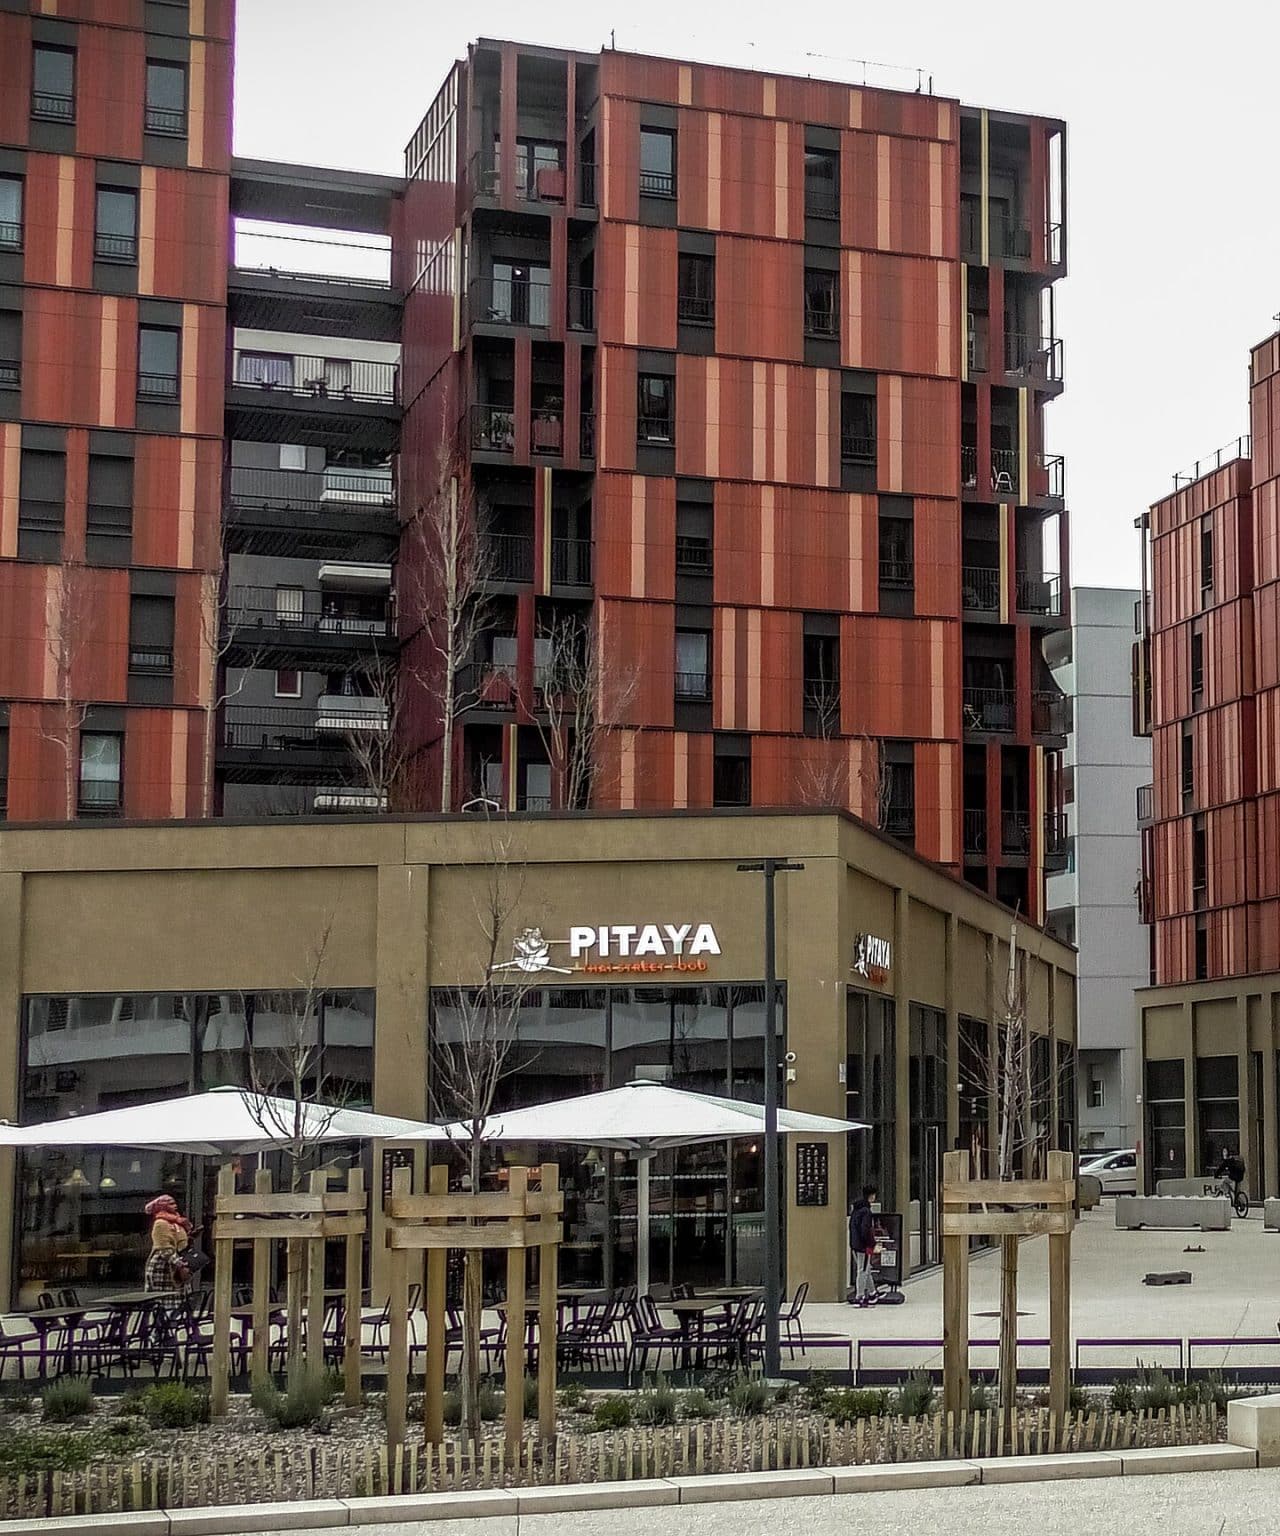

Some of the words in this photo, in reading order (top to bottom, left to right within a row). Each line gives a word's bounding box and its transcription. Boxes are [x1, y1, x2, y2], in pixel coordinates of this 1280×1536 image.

[570, 924, 722, 957] PITAYA
[866, 934, 890, 970] PITAYA
[617, 961, 666, 973] STREET
